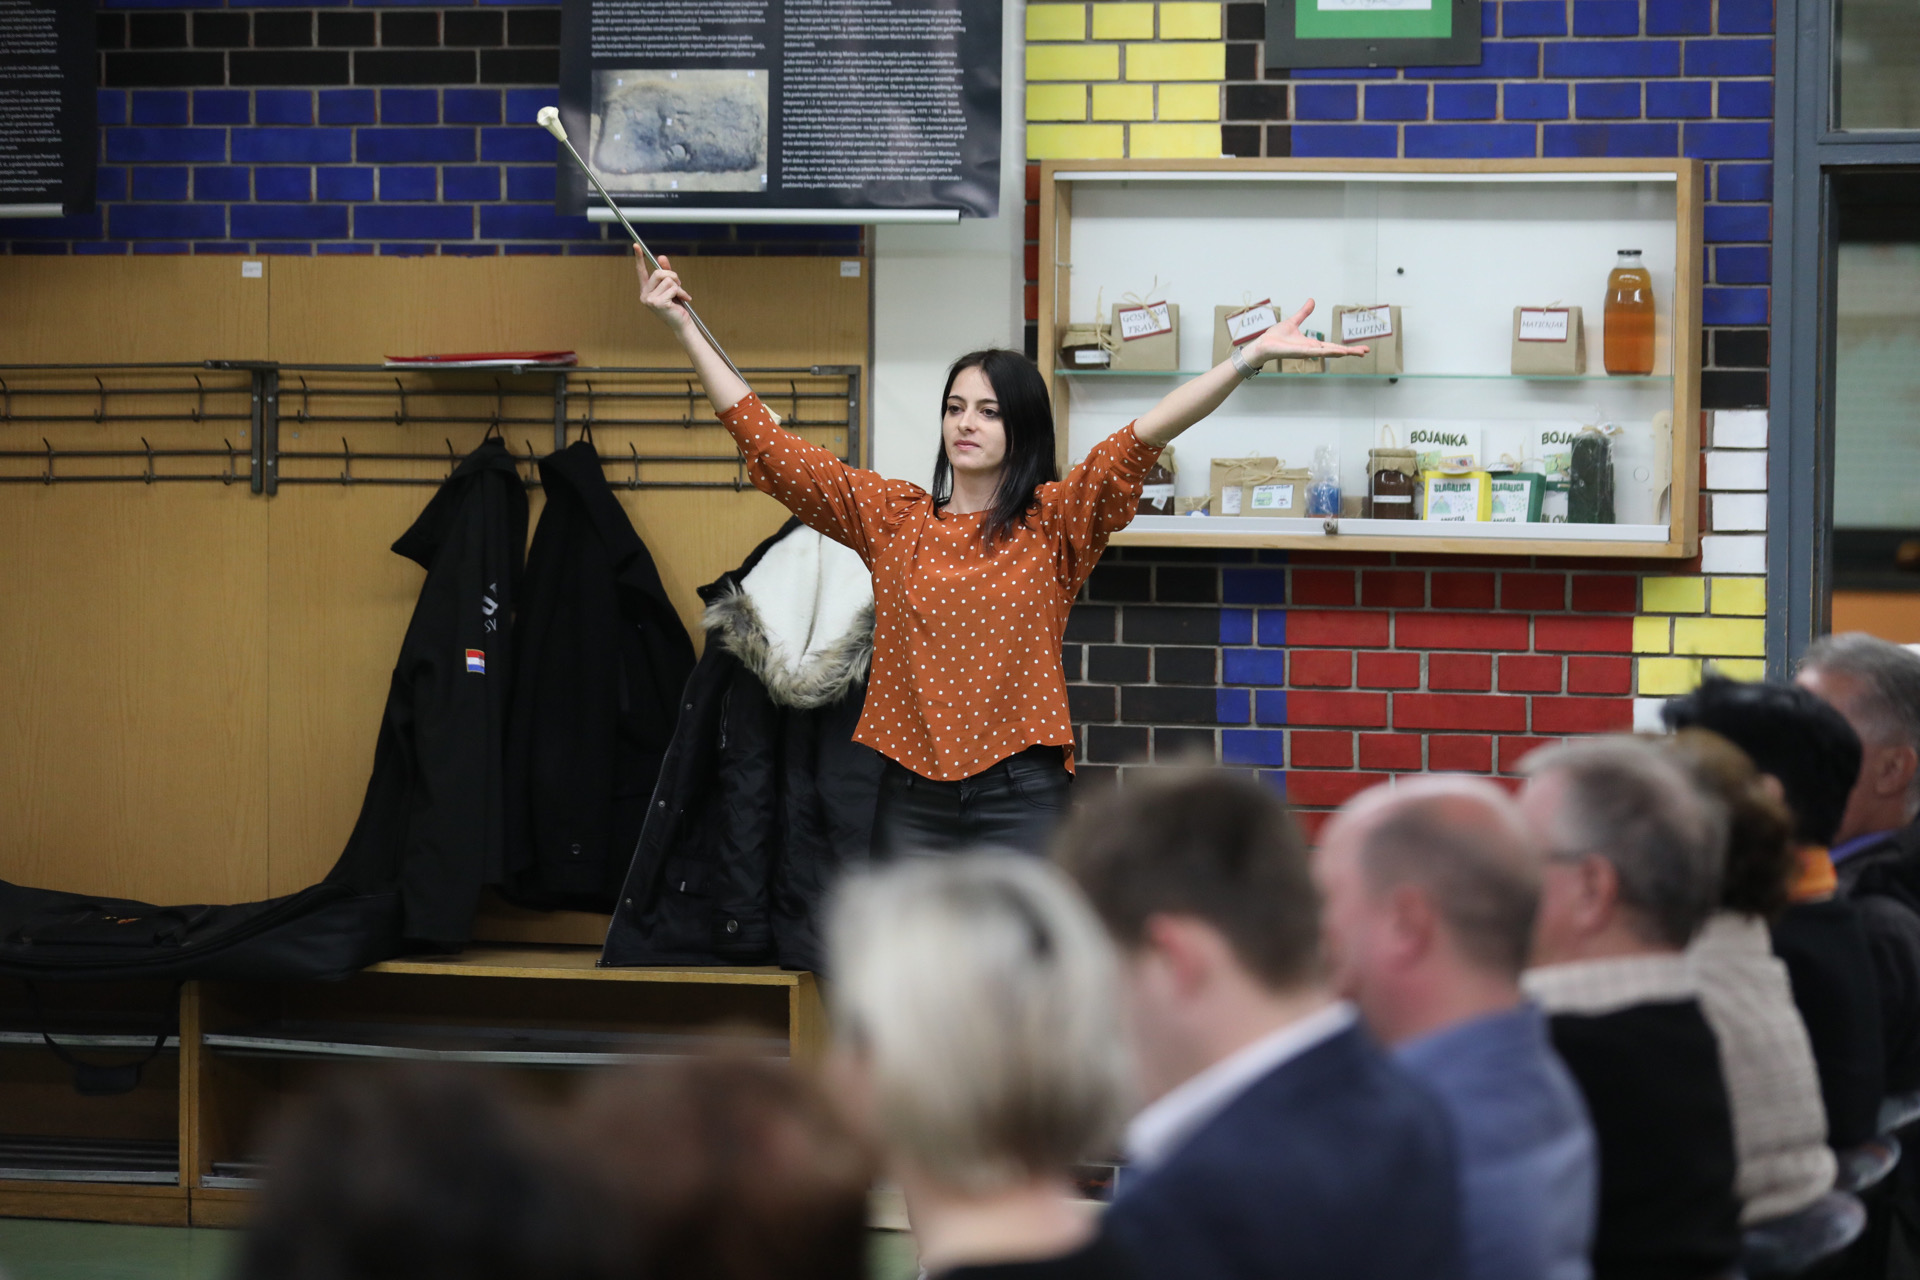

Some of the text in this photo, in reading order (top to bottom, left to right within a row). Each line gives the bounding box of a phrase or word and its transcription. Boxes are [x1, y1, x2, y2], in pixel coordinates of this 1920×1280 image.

[1241, 312, 1264, 328] LIPA
[1410, 430, 1468, 447] BOJANKA
[1541, 431, 1572, 446] BOJA
[1434, 482, 1471, 493] SLAGALICA
[1492, 483, 1524, 493] SLAGALICA
